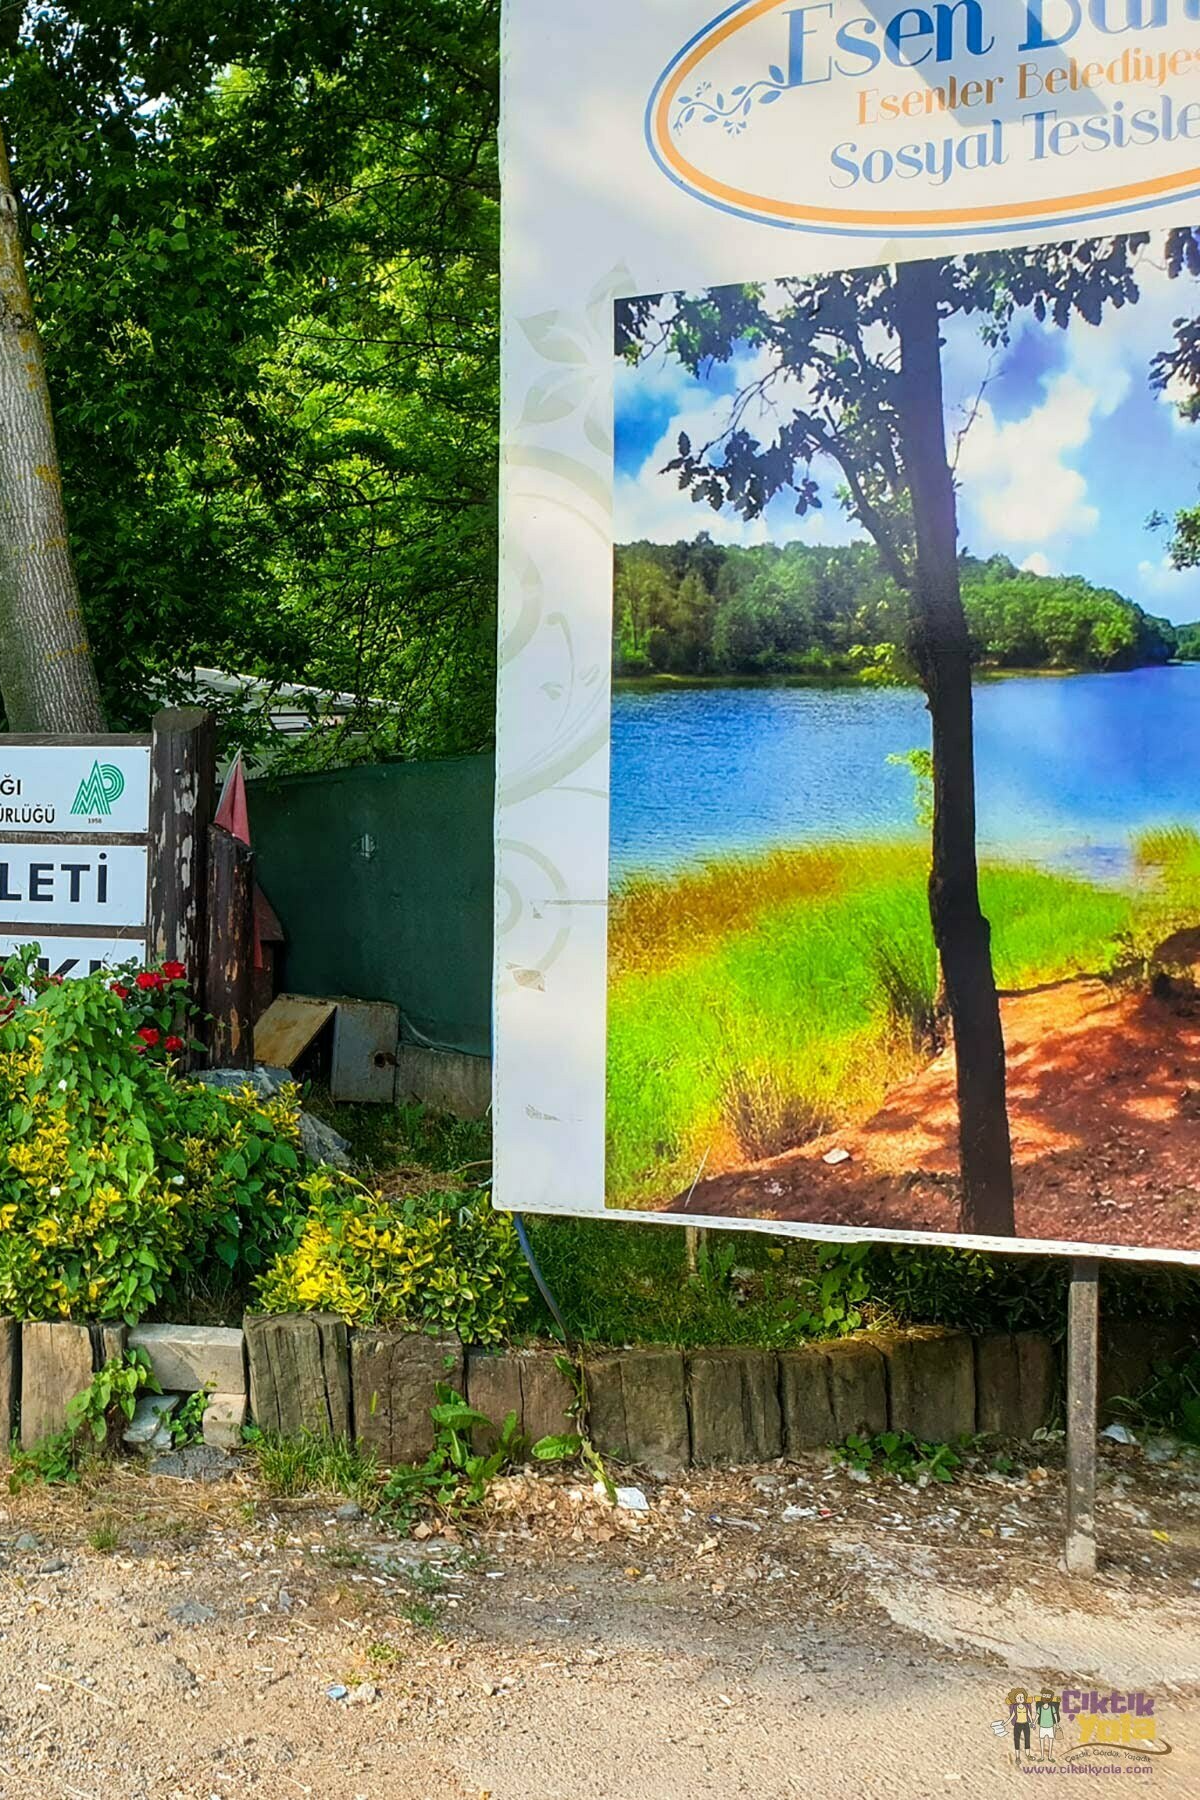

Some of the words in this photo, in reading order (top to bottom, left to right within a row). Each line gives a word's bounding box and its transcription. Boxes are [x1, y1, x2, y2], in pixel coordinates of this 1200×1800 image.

[782, 0, 995, 87] Esen
[856, 75, 1004, 125] Esenler
[829, 119, 1009, 189] Sosyal
